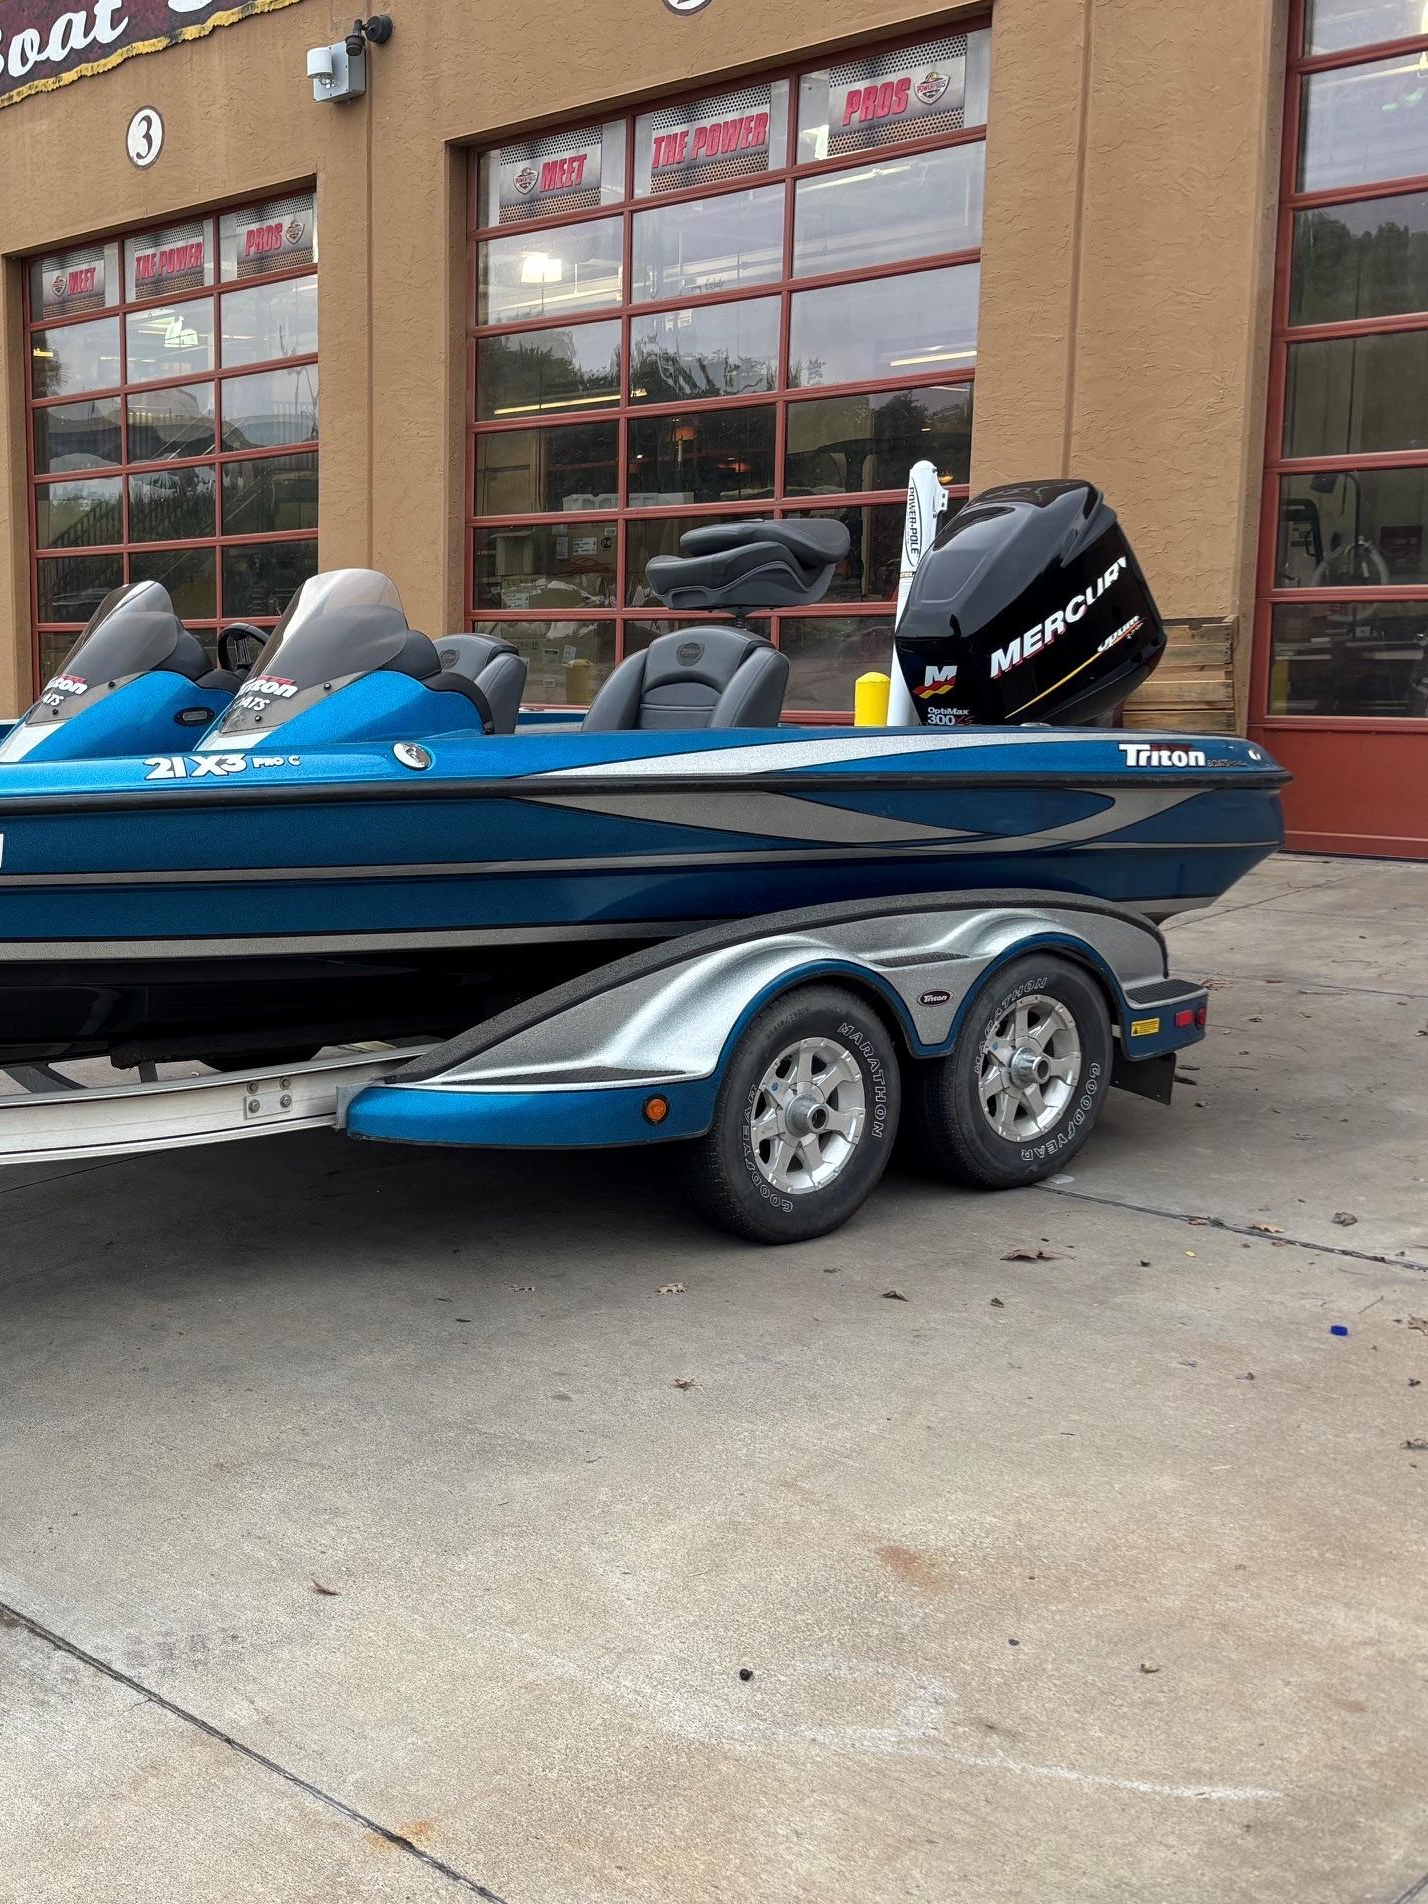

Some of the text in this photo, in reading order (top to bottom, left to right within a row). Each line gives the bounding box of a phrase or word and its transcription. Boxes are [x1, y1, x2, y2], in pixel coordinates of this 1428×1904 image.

[842, 77, 911, 126] PROS
[136, 115, 153, 159] 3
[652, 112, 769, 169] THE POWER
[540, 154, 587, 193] MEET
[245, 222, 283, 256] PROS
[136, 242, 204, 280] THE POWER
[67, 267, 96, 295] MEET
[908, 486, 920, 555] POWER-POLE
[232, 696, 271, 711] ATS
[927, 706, 970, 716] OptiMax
[927, 714, 956, 727] 300
[288, 754, 301, 767] C
[1118, 743, 1206, 767] Triton
[837, 1022, 887, 1138] MARATHON
[1021, 1062, 1101, 1161] GOODYEAR
[742, 1084, 793, 1213] GOODYEAR
